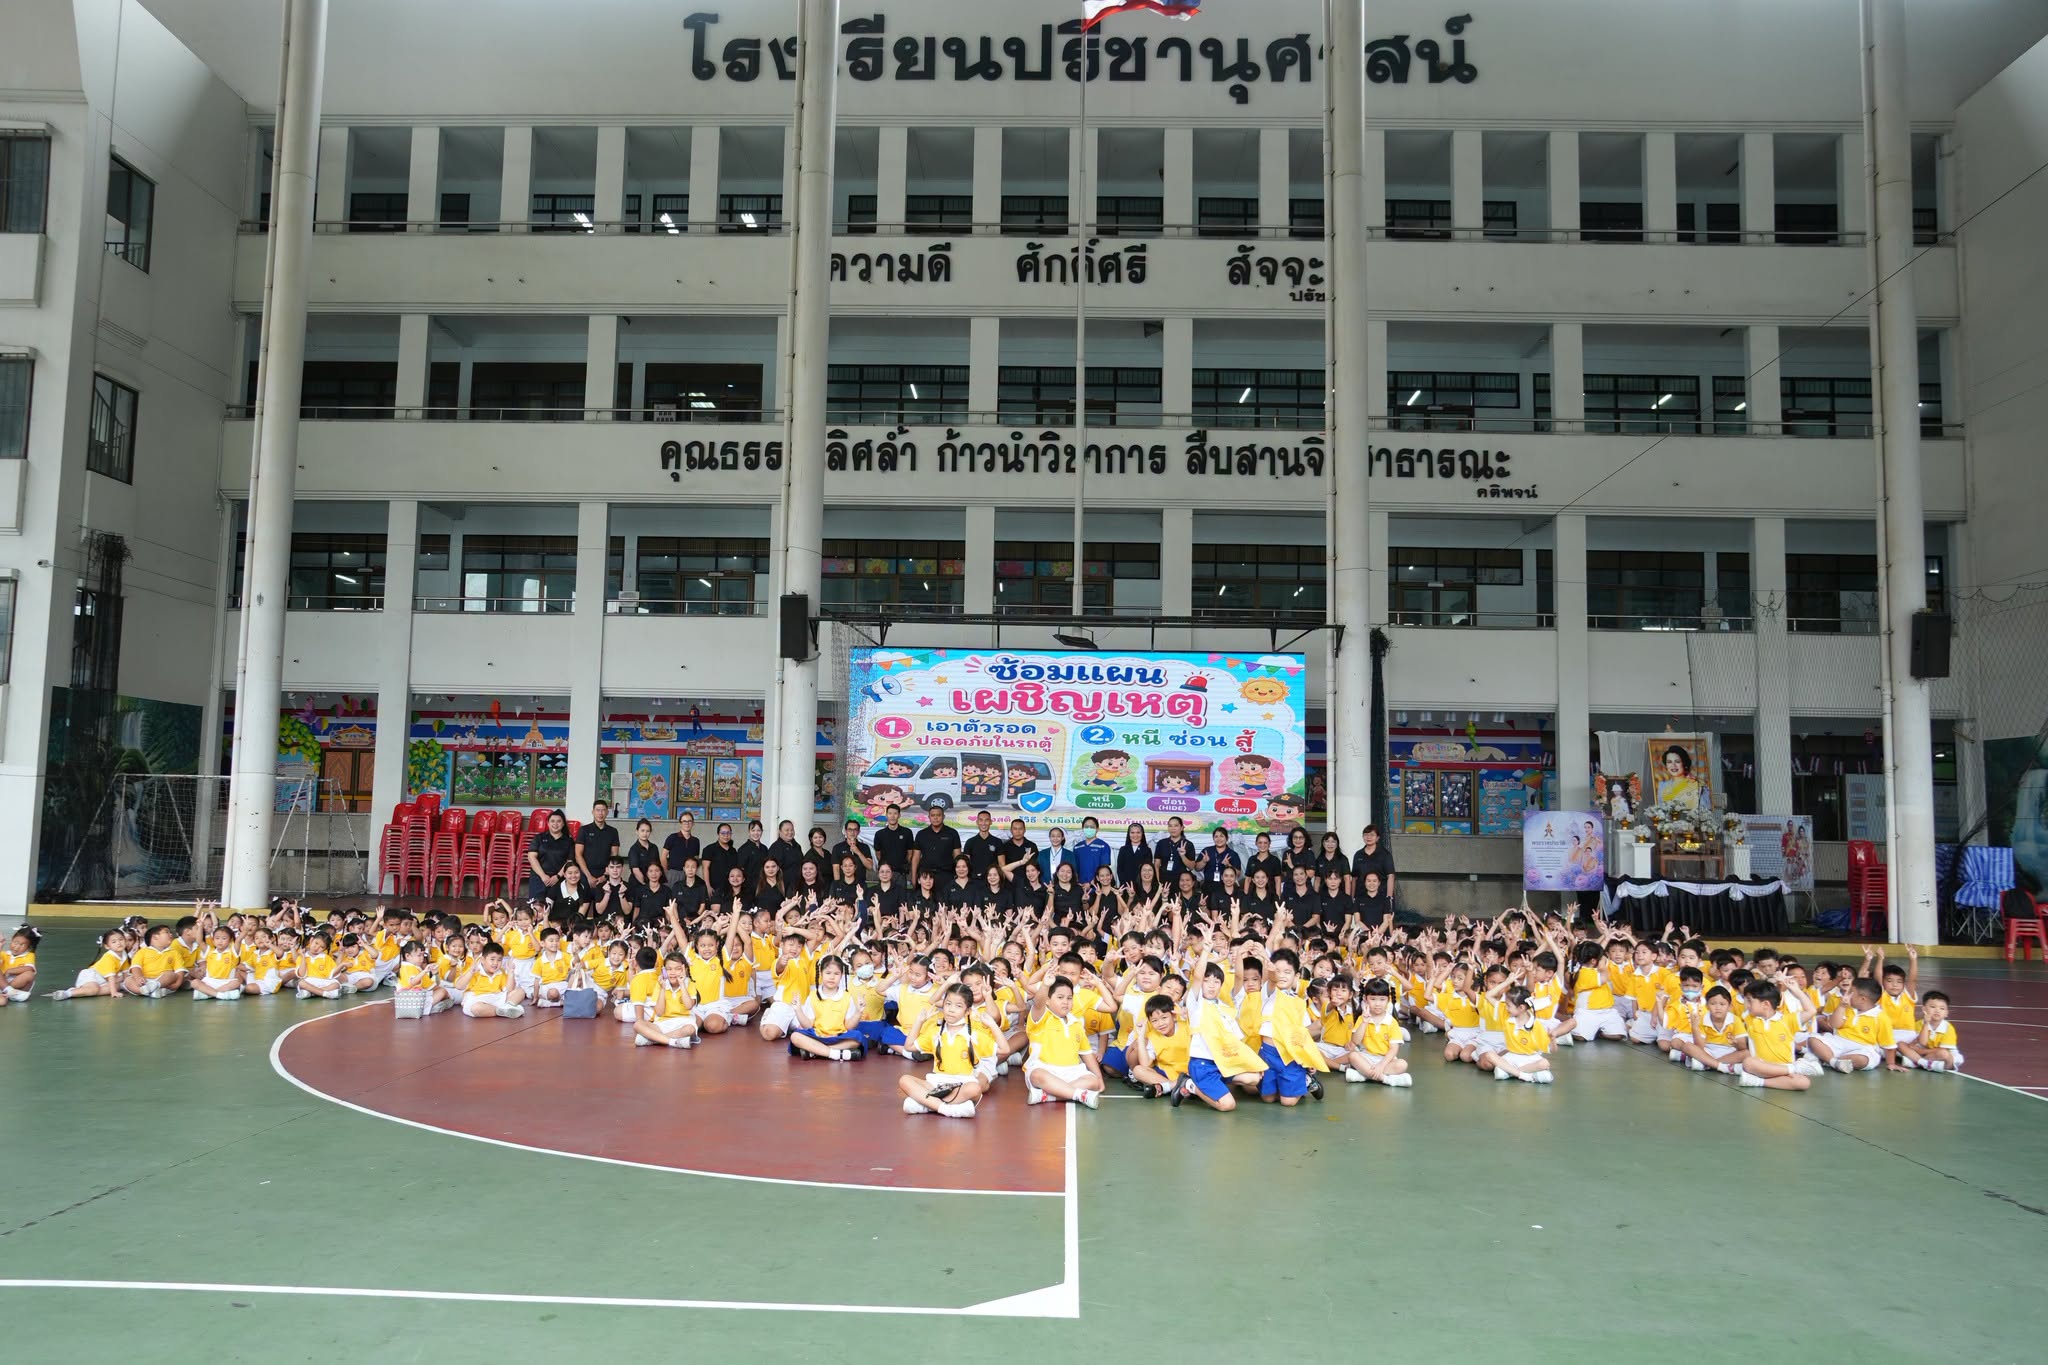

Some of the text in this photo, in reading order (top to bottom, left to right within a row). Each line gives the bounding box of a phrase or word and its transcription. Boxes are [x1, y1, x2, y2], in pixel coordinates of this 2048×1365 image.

[684, 12, 1478, 104] โรงรียนปรีชานุศสน์
[831, 239, 1325, 285] ความดี ศักดิ์ศรี สัจจะ
[1289, 288, 1325, 302] ปรัช
[660, 426, 917, 482] คุณธรรลิศล้ำ
[1185, 430, 1511, 479] สืบสานจิาธารณะ
[1477, 484, 1538, 498] คติพจน์
[988, 657, 1164, 684] ซ้อมแผน
[952, 682, 1203, 726] เผชิญเหตุ
[926, 719, 1036, 734] เอาตัวรอด
[916, 735, 1052, 752] ปลอดภัยในรถตู้
[1122, 729, 1161, 745] หนี
[1169, 730, 1227, 747] ซ่อน
[1235, 729, 1256, 752] สู้
[1158, 804, 1188, 812] (HIDE)
